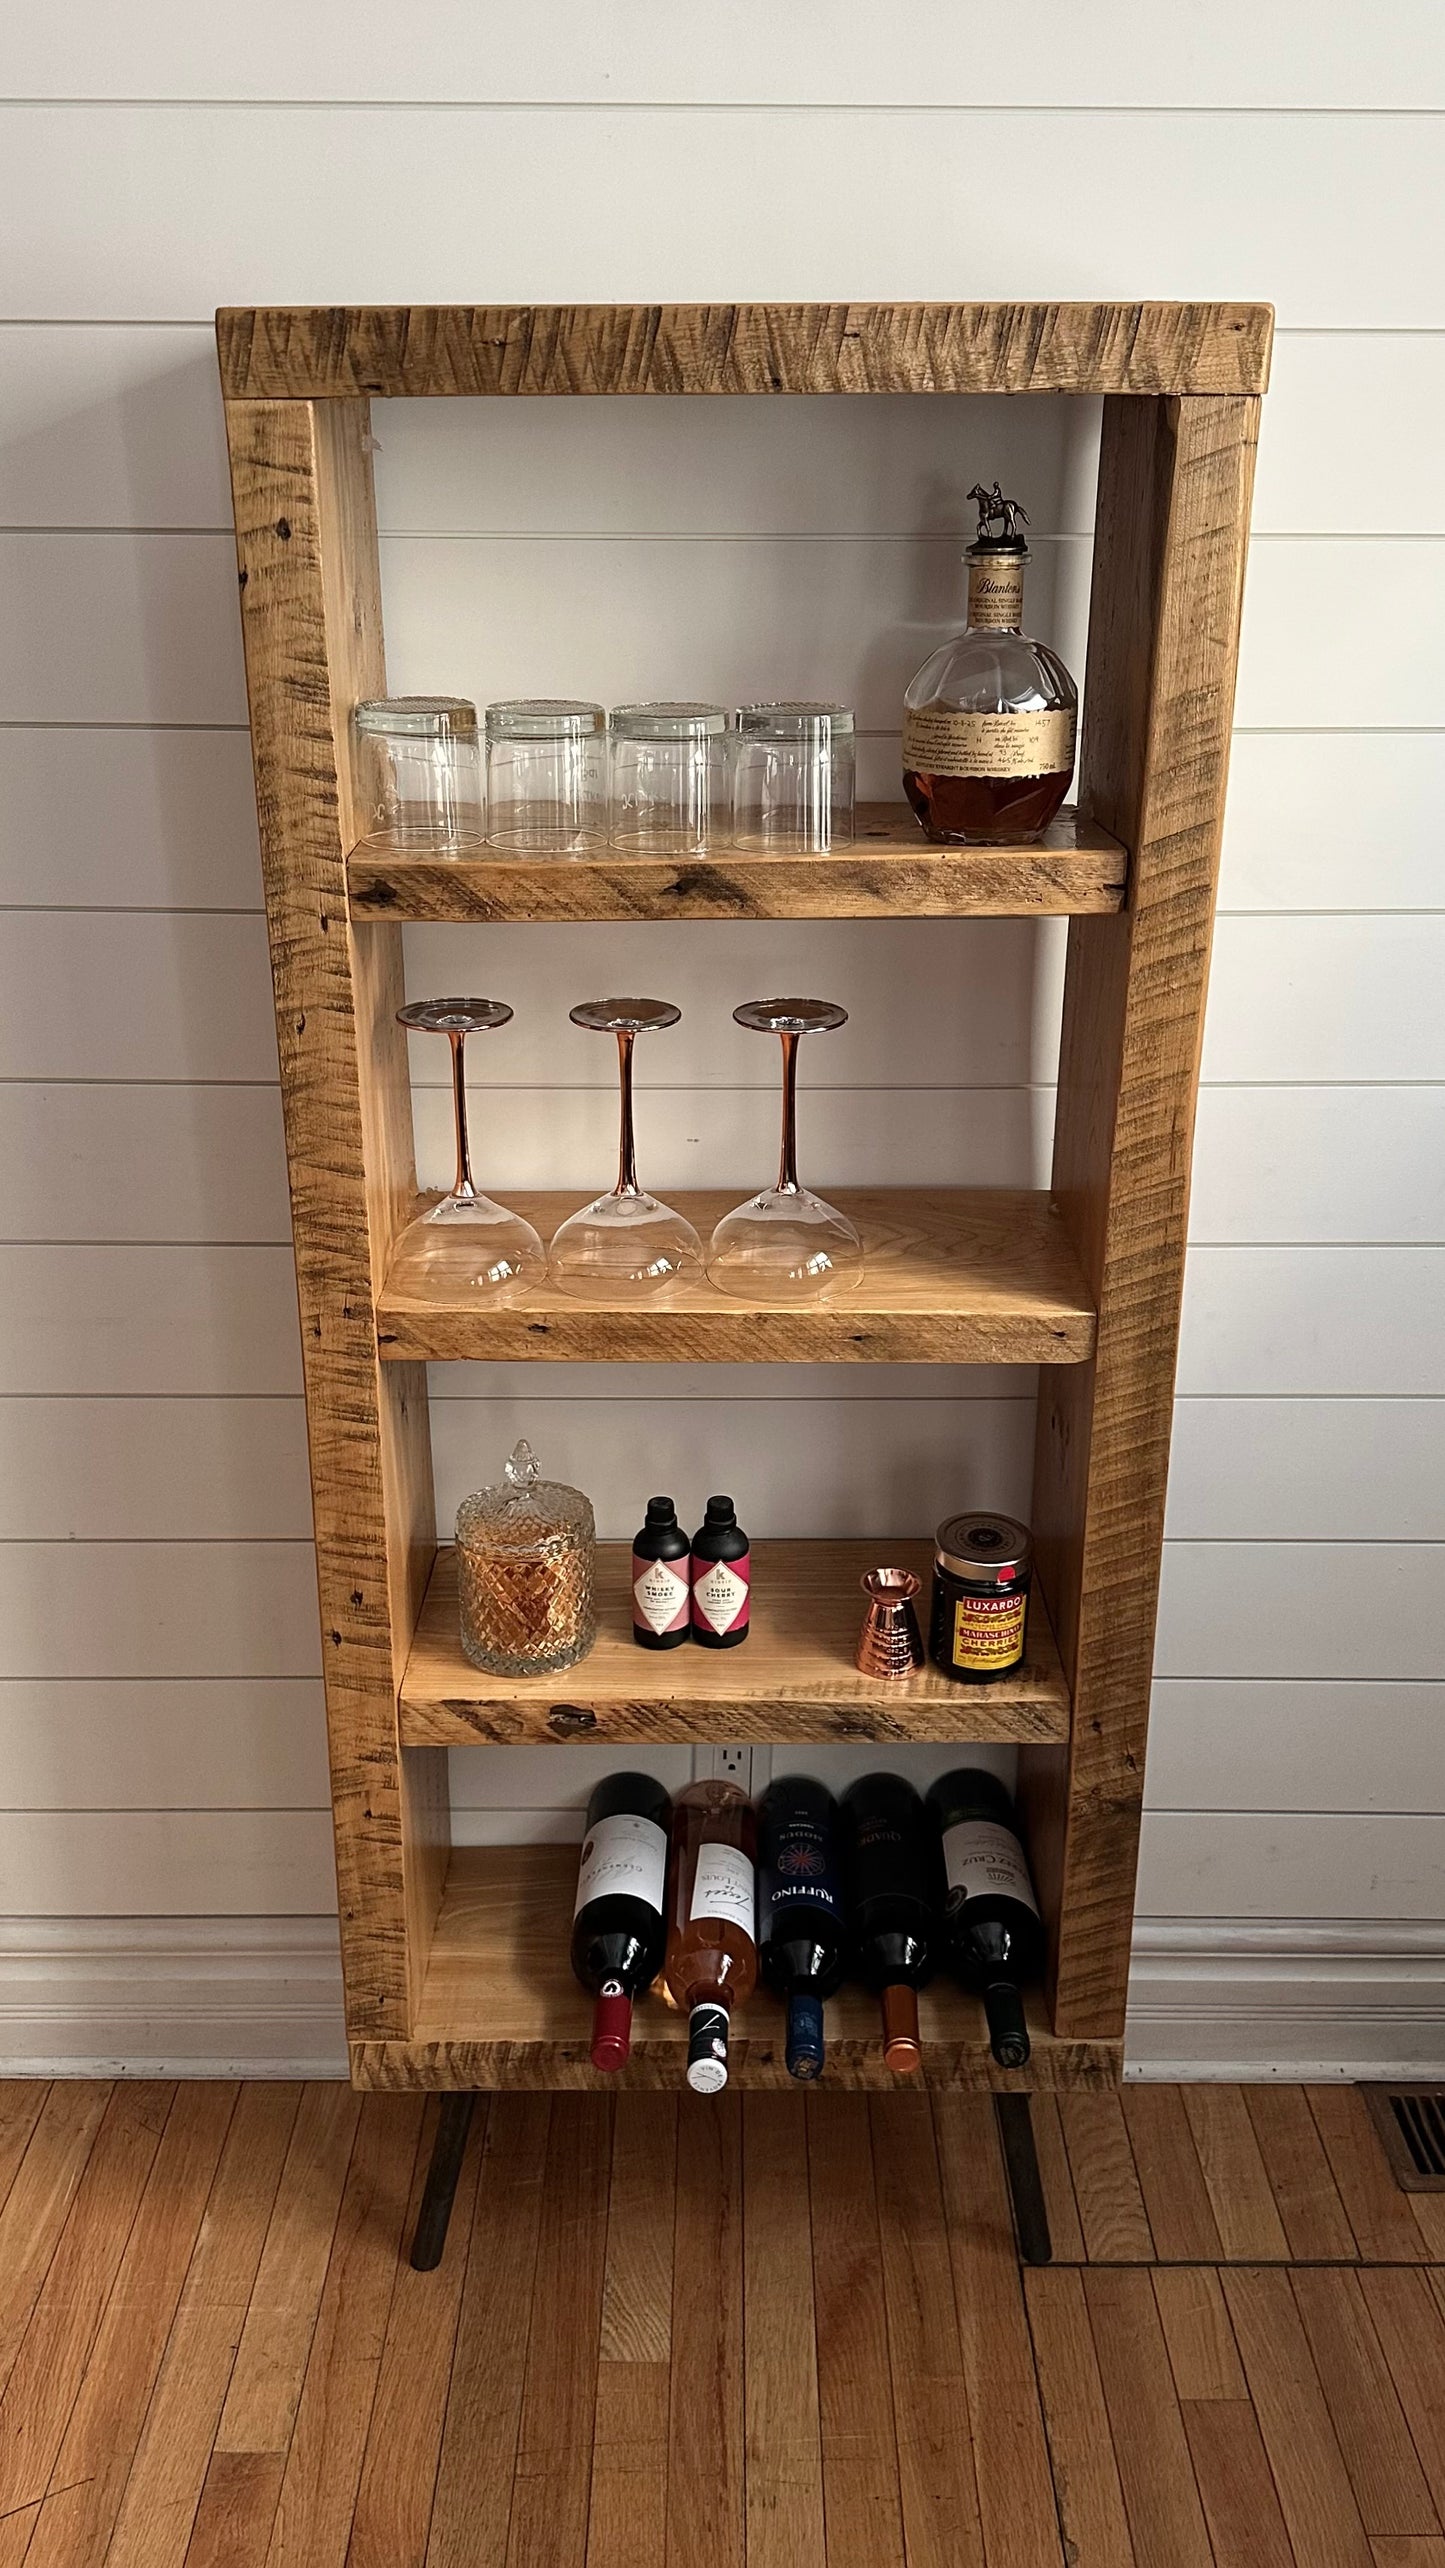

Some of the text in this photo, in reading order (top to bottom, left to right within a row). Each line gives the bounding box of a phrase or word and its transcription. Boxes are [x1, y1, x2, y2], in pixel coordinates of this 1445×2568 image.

[1039, 762, 1049, 771] 750
[966, 1596, 1021, 1612] LUXARDO
[962, 1623, 1021, 1639] MARASCHINO
[961, 1633, 1020, 1648] CHERRIES
[771, 1885, 834, 1905] RUFFINO
